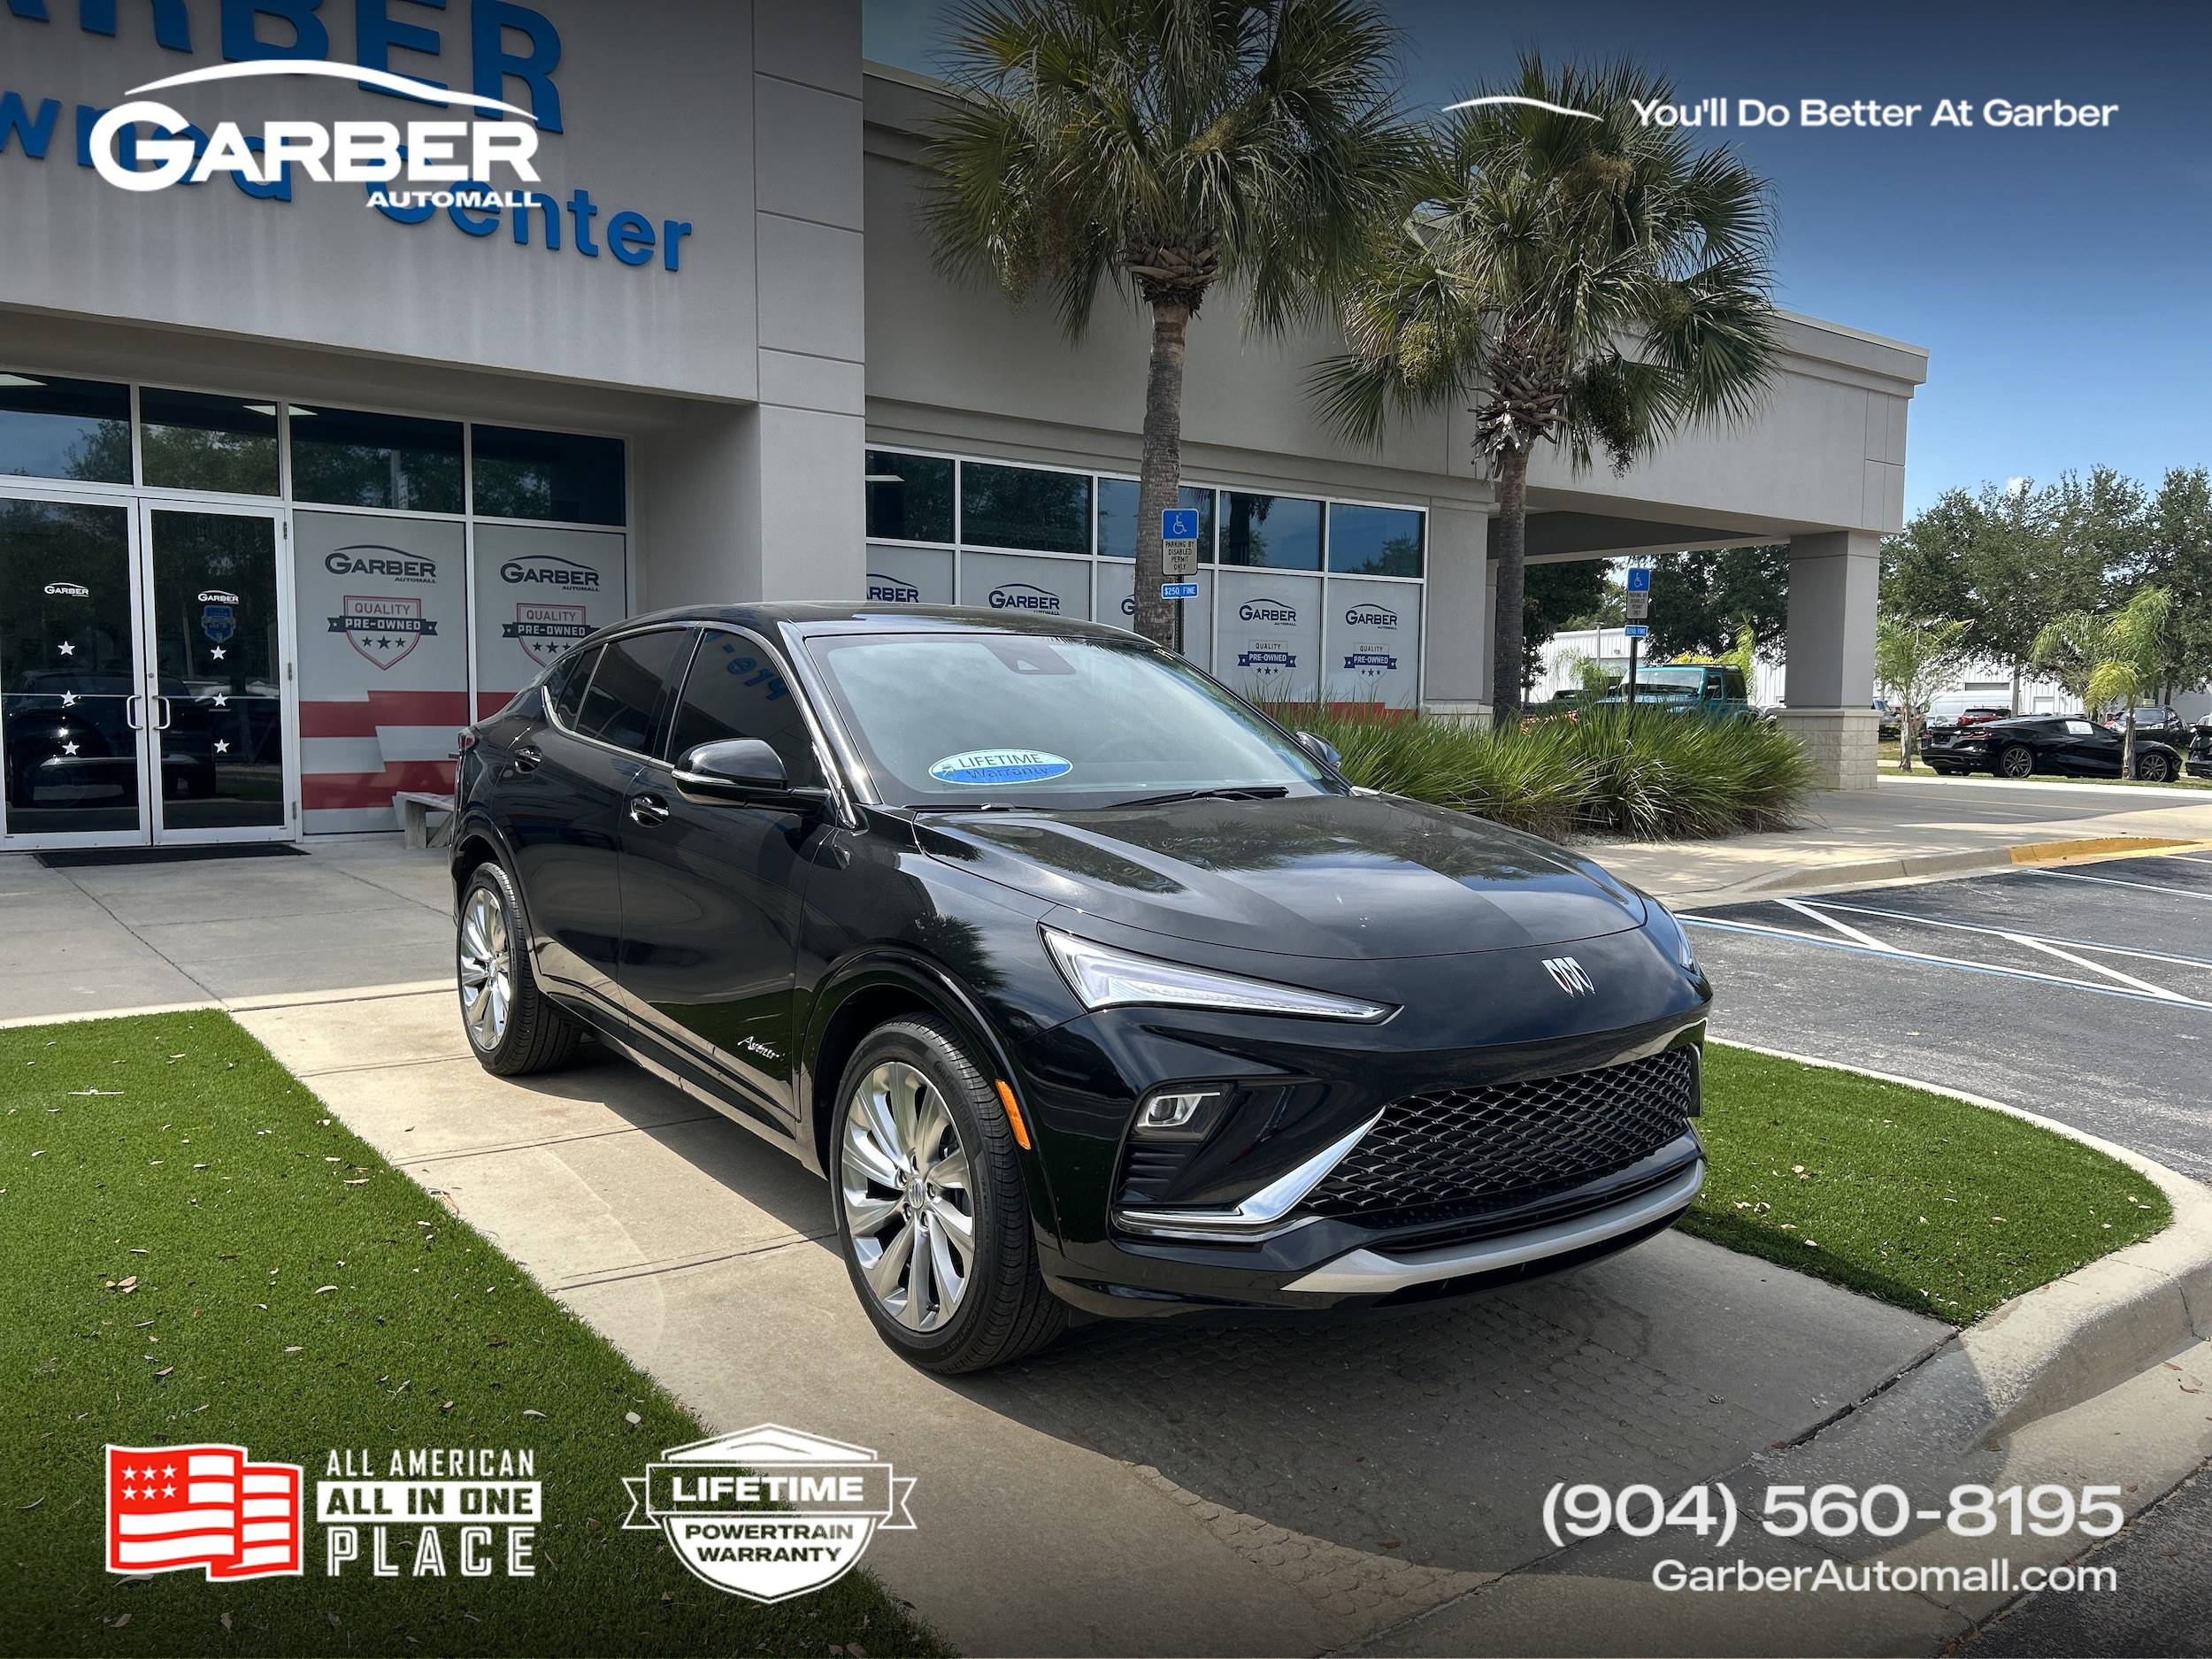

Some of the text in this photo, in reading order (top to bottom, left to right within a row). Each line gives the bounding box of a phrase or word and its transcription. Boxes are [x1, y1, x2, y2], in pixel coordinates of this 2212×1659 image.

[7, 0, 564, 134] BER
[365, 144, 692, 272] Center
[325, 552, 437, 578] GARBER
[500, 562, 600, 587] GARBER
[44, 585, 89, 595] GARBER
[866, 586, 919, 603] RBER
[1183, 586, 1195, 595] FINE
[988, 590, 1060, 610] GARBER
[355, 603, 411, 615] QUALITY
[526, 610, 576, 622] QUALITY
[1239, 604, 1297, 622] GARBER
[345, 618, 421, 631] PRE-OWNED
[1345, 610, 1398, 626] GARBER
[518, 624, 586, 636] PRE-OWNED
[1248, 652, 1287, 663] PRE-OWNED
[1354, 655, 1389, 664] PRE-OWNED
[958, 754, 1043, 768] LIFETIME
[966, 765, 1048, 780] Warranty
